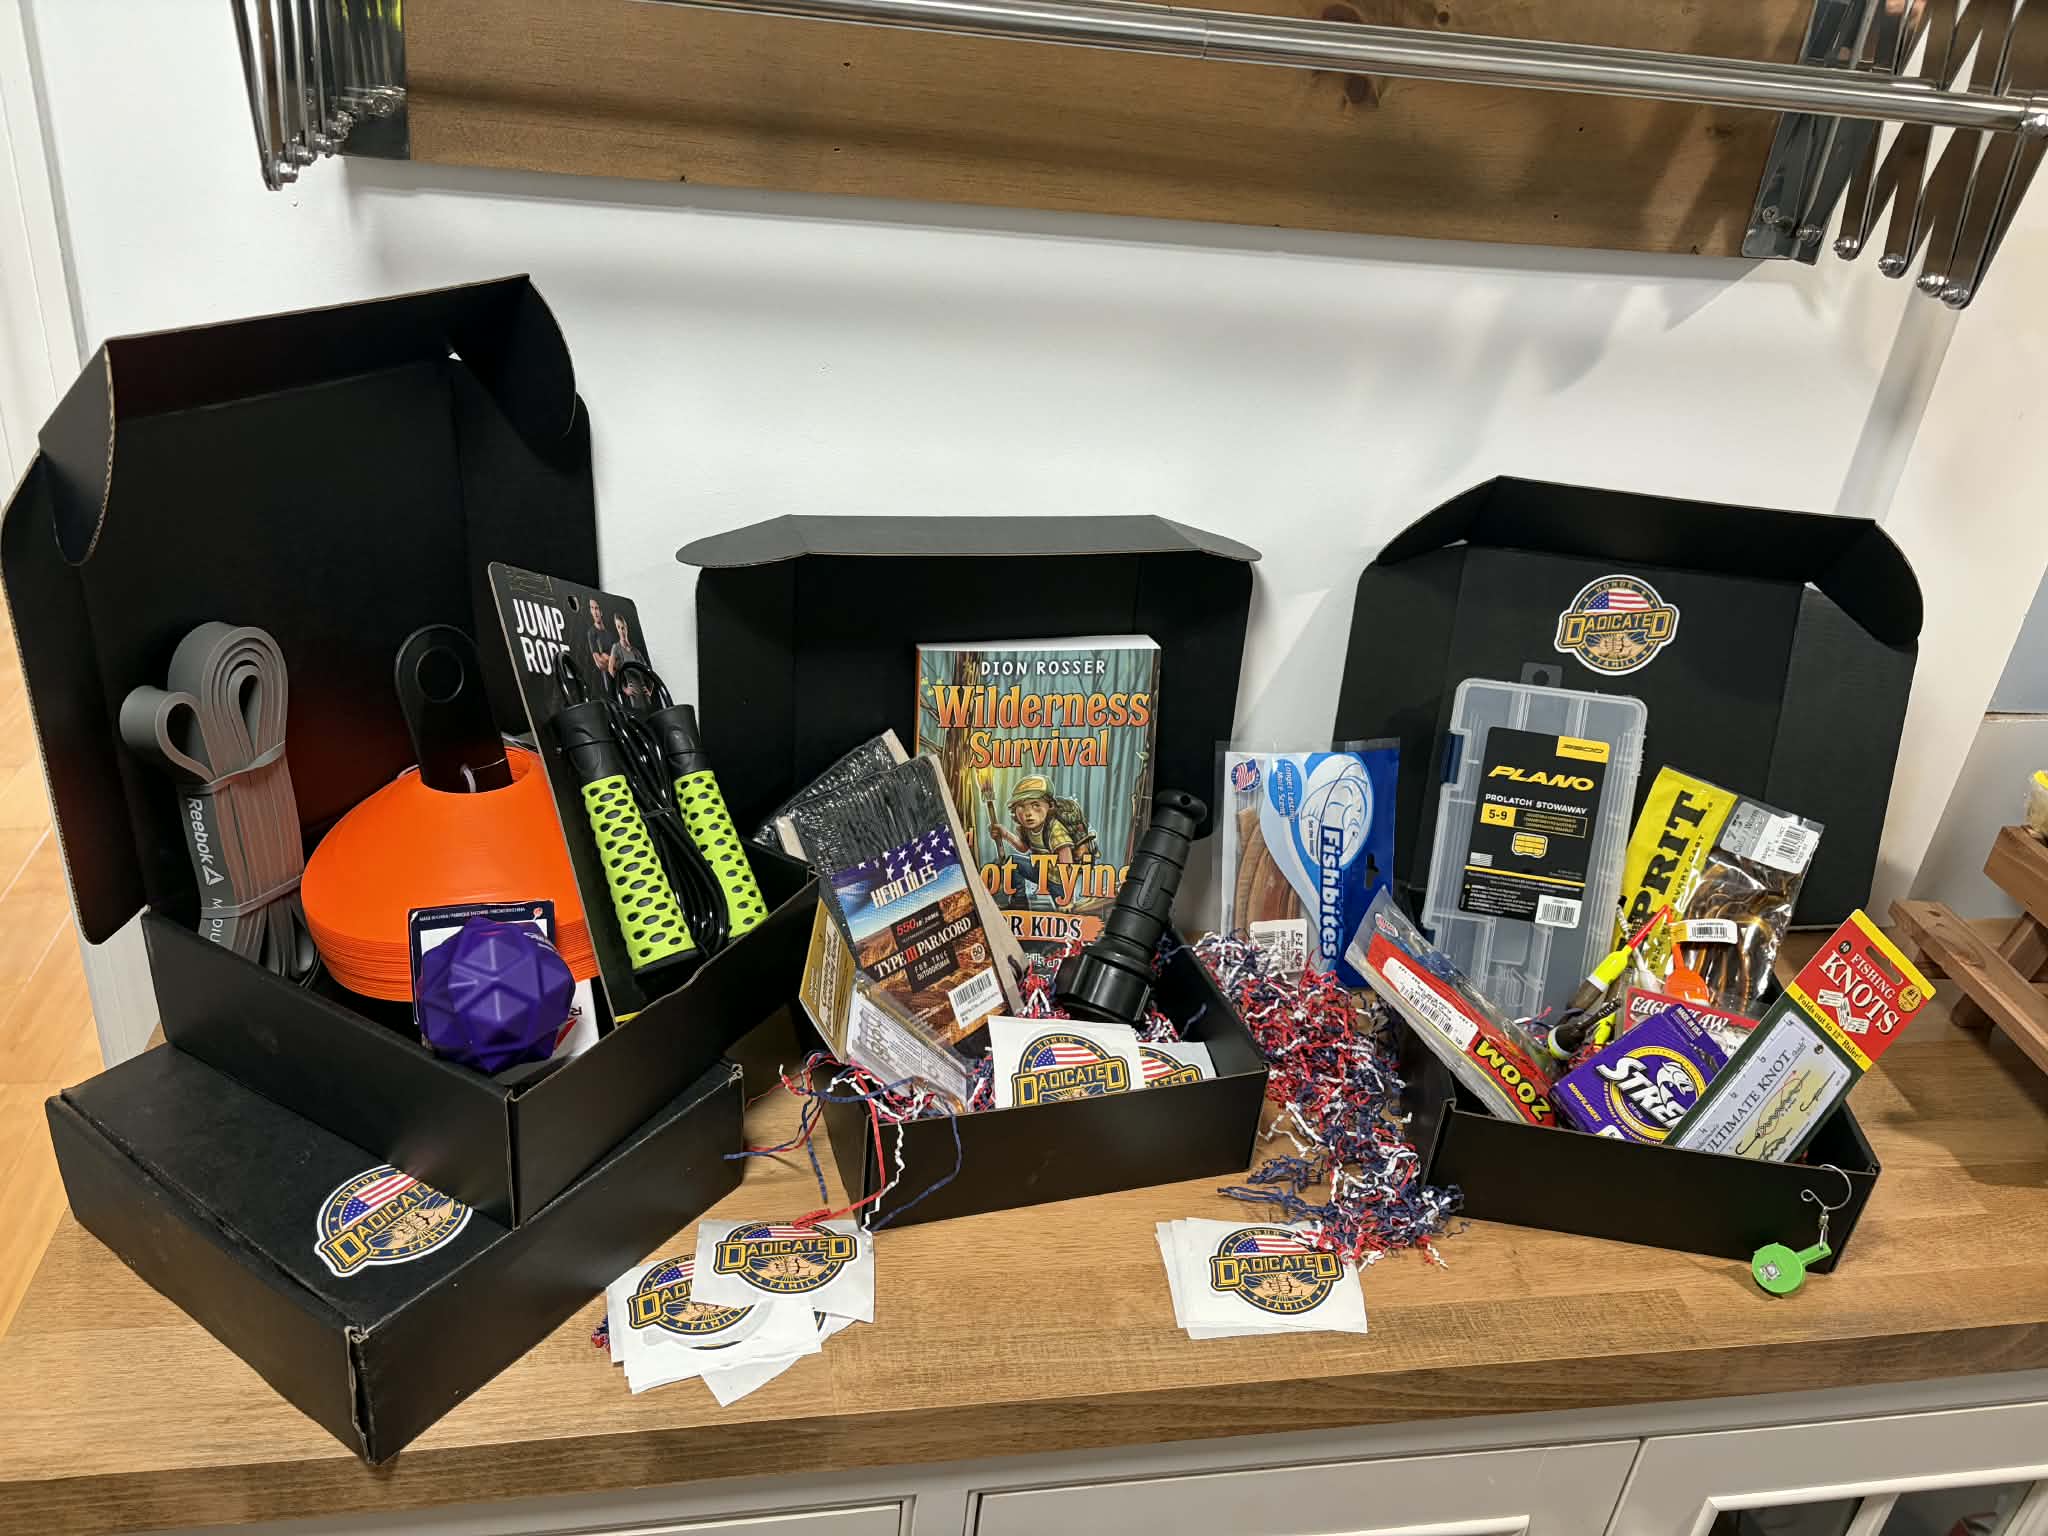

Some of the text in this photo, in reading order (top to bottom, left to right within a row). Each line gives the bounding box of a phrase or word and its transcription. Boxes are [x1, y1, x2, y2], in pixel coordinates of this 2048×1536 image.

[512, 599, 566, 641] JUMP
[1565, 611, 1671, 643] DADICATED
[520, 636, 570, 675] ROP
[981, 660, 1105, 676] DION ROSSER
[932, 684, 1151, 729] Wilderness
[969, 729, 1112, 769] Survival
[1487, 765, 1595, 791] PLANO
[1485, 793, 1588, 815] PROLATCH STOWAWAY
[1488, 809, 1508, 821] 5-9
[186, 797, 214, 865] Reebok
[979, 854, 1018, 896] ot
[1624, 790, 1708, 932] PRIT
[869, 862, 938, 910] HERCULES
[1321, 827, 1343, 959] Fishbites
[209, 897, 223, 943] MDIU
[1031, 915, 1082, 939] KIDS
[874, 952, 907, 979] TYPE
[916, 916, 972, 956] PARACORD
[1819, 950, 1900, 1034] KNOTS
[1850, 953, 1896, 1000] FISHING
[1631, 996, 1671, 1015] EAG
[1798, 993, 1815, 1013] Folds
[1814, 1011, 1826, 1024] out
[1018, 1060, 1124, 1105] DADICATED
[1475, 1040, 1551, 1121] ZOOM
[1757, 1049, 1792, 1093] KNOT
[334, 1172, 382, 1207] HONOR
[331, 1182, 435, 1267] DADICAT
[724, 1236, 851, 1269] DADICATED
[1218, 1253, 1337, 1286] DADICATED
[767, 1275, 820, 1290] FAMILY
[1265, 1296, 1313, 1311] FAMILY
